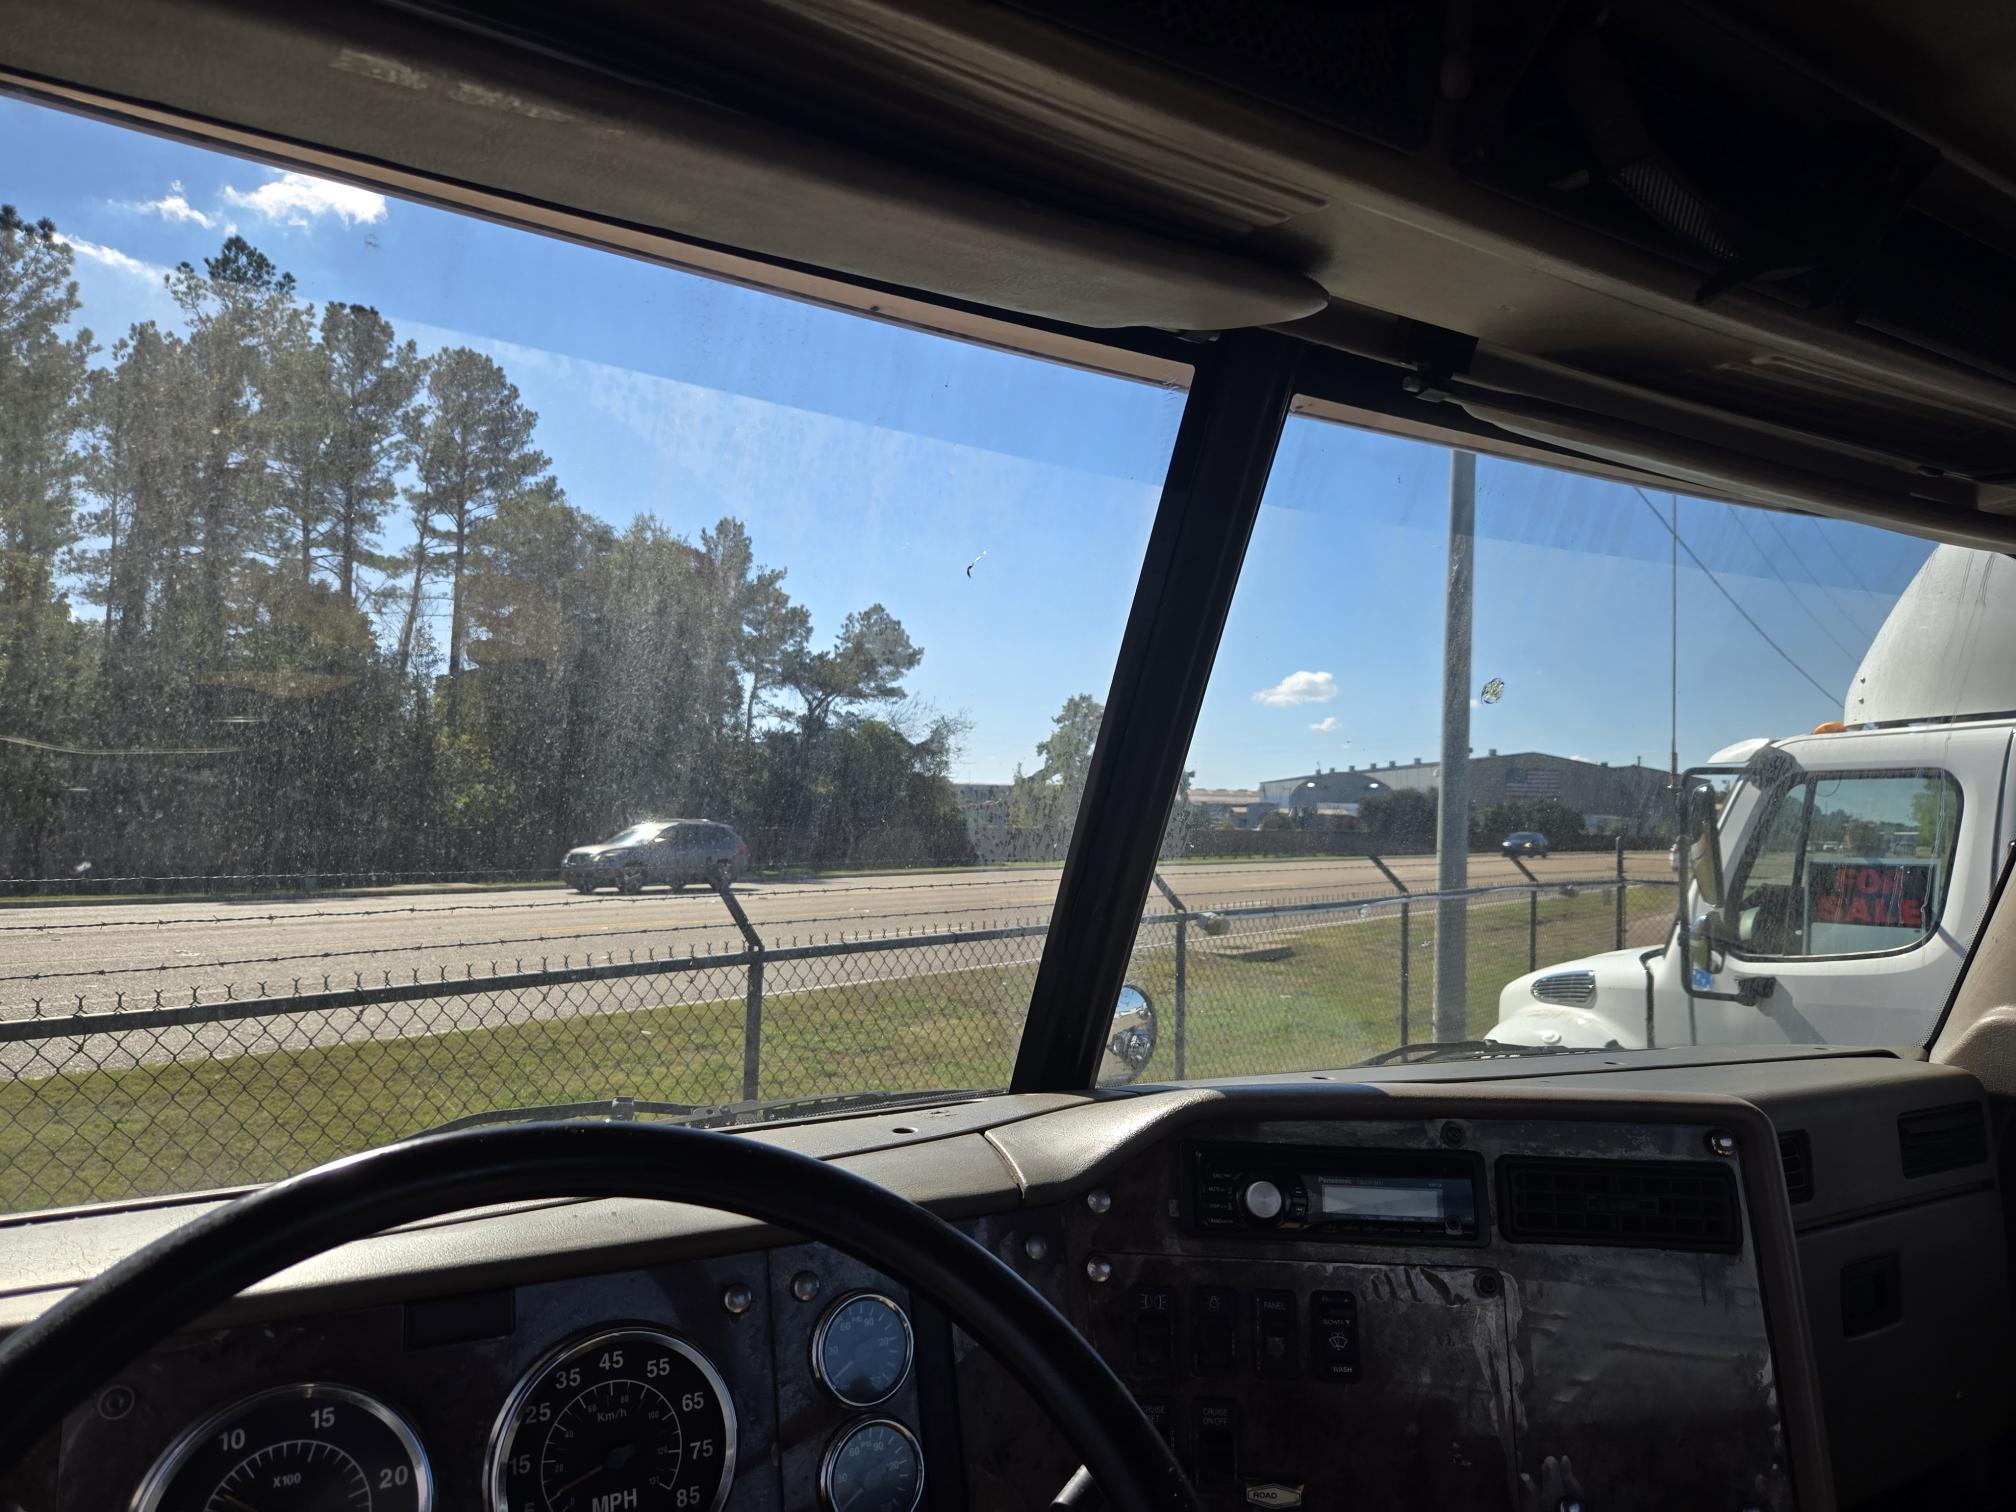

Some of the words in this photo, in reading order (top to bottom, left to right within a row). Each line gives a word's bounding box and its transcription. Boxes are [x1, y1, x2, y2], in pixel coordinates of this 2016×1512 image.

[1817, 896, 1922, 926] SALE
[599, 1350, 624, 1370] 45
[646, 1358, 670, 1378] 55
[555, 1368, 581, 1390] 35
[682, 1392, 705, 1412] 65
[1202, 1407, 1228, 1416] CRUISE
[310, 1406, 336, 1429] 15
[525, 1402, 551, 1424] 25
[597, 1409, 627, 1423] Km/h
[219, 1428, 246, 1451] 10
[689, 1439, 713, 1460] 75
[873, 1441, 884, 1451] 90
[510, 1454, 531, 1476] 15
[273, 1472, 302, 1488] X100
[379, 1465, 409, 1490] 20
[592, 1488, 638, 1512] MPH
[676, 1486, 701, 1508] 85
[1253, 1492, 1277, 1500] ROAD
